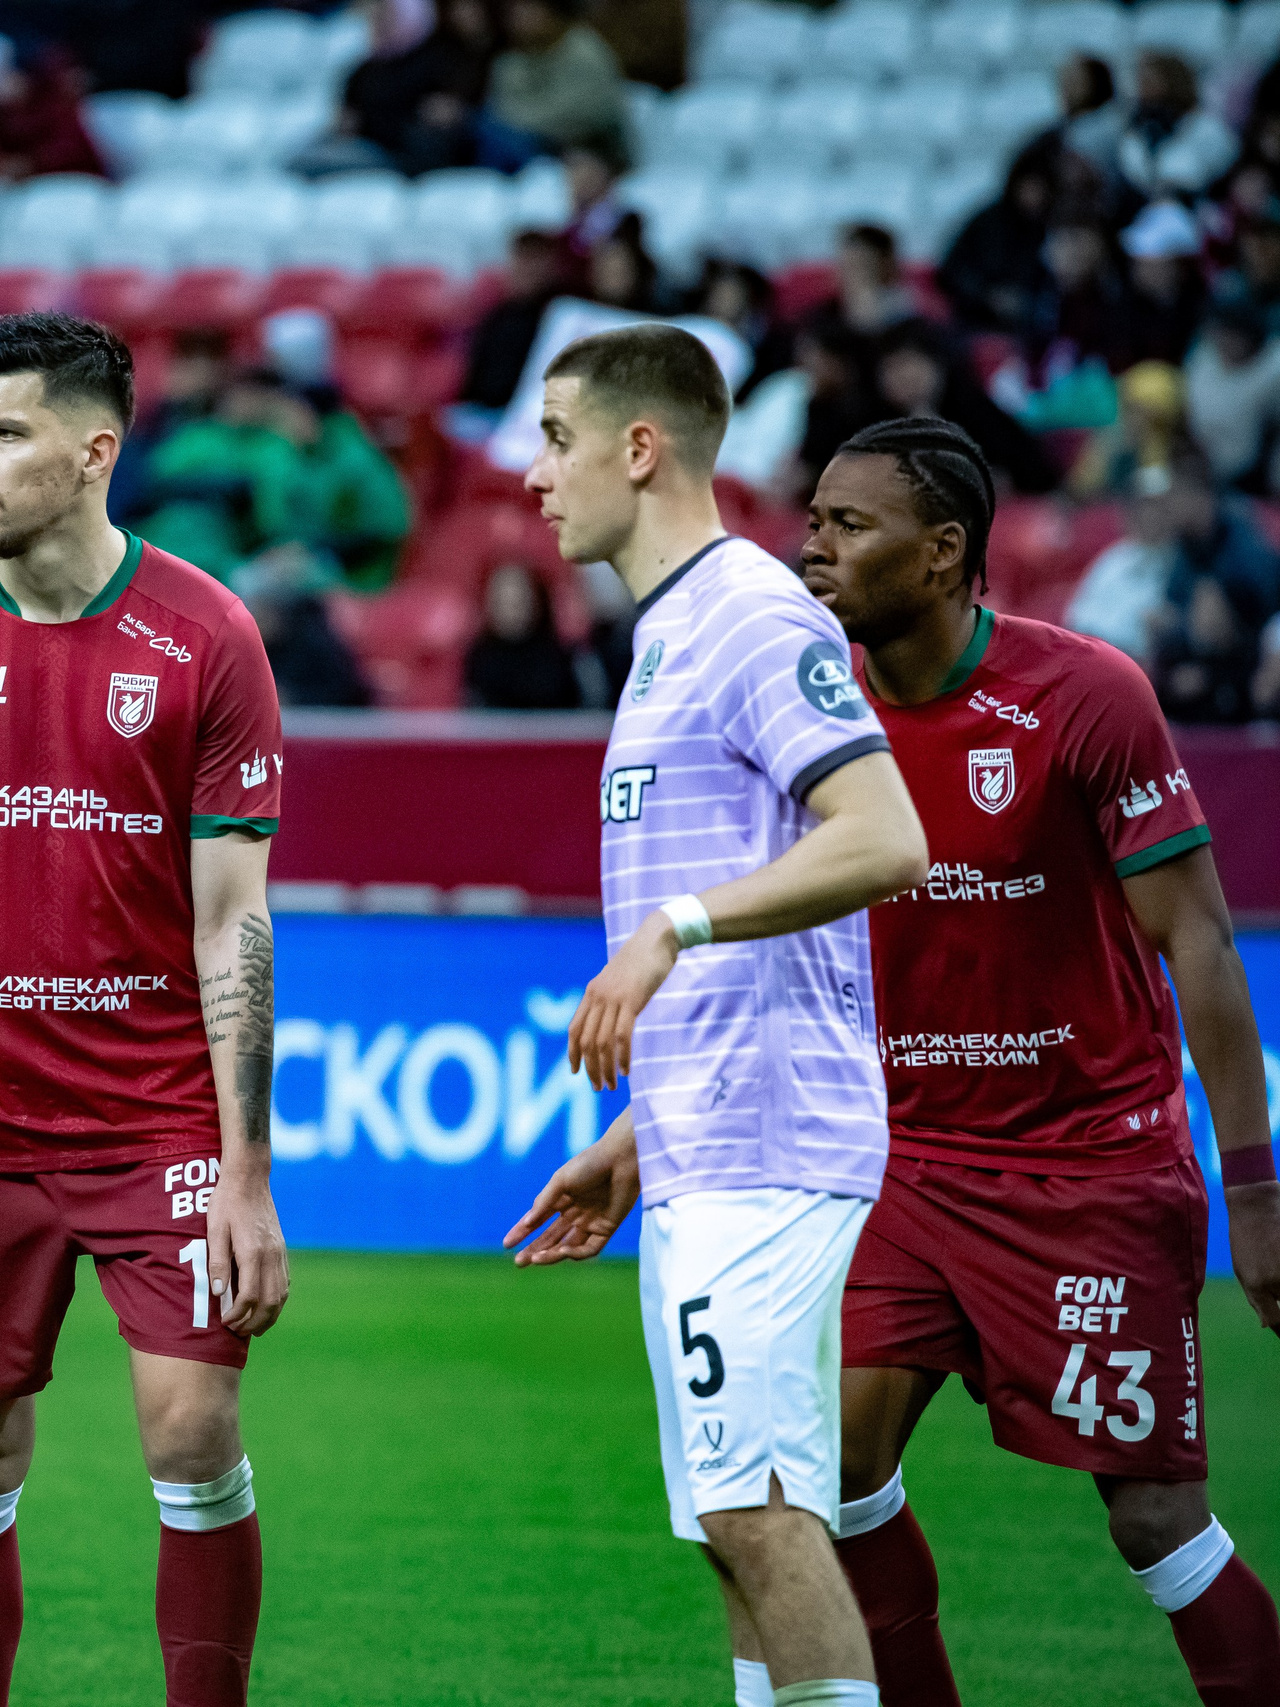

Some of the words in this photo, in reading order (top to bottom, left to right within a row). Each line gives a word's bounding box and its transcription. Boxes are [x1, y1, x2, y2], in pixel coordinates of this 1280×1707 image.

[113, 675, 156, 688] РУБИН
[818, 683, 862, 710] LAD
[970, 751, 1011, 761] РУБИН
[927, 862, 984, 882] АНЬ
[888, 1023, 1076, 1051] НИЖНЕКАМСК
[891, 1050, 1040, 1068] НЕФТЕХИМ
[172, 1186, 215, 1220] BE
[1054, 1275, 1127, 1304] FON
[1057, 1304, 1129, 1334] BET
[679, 1295, 725, 1398] 5
[1051, 1343, 1156, 1443] 43
